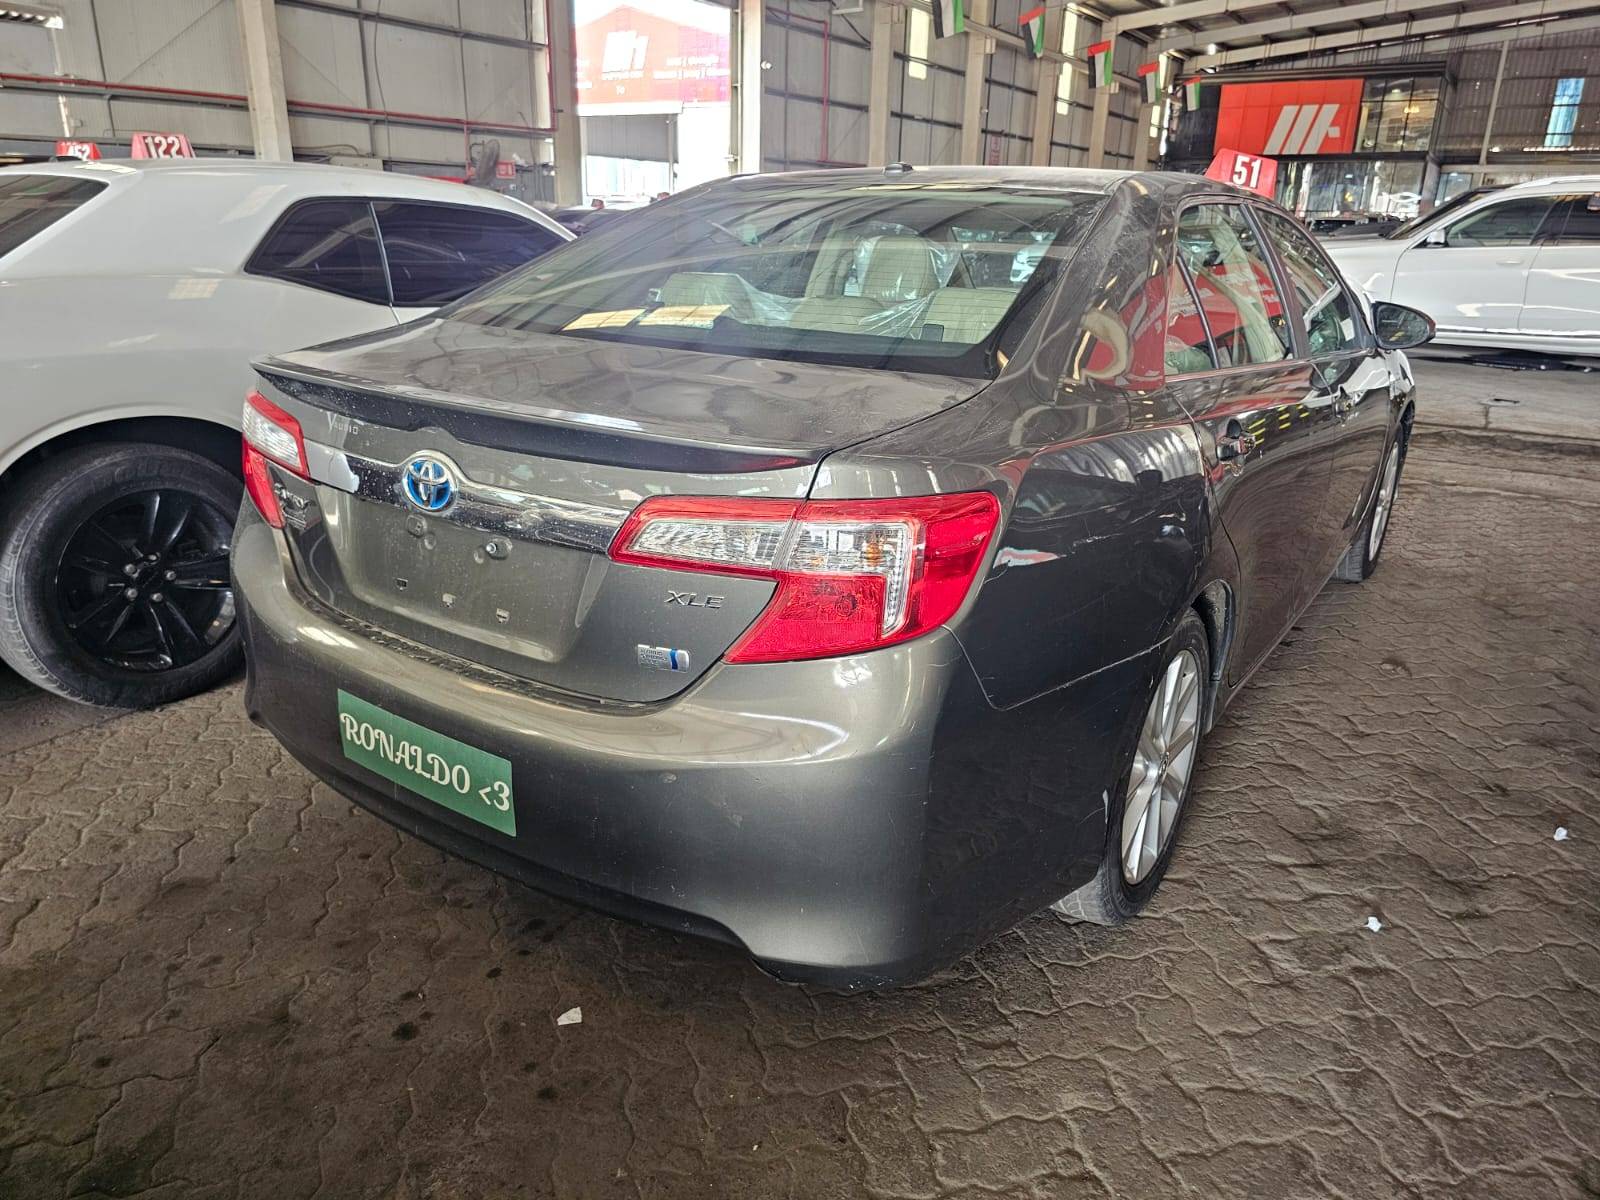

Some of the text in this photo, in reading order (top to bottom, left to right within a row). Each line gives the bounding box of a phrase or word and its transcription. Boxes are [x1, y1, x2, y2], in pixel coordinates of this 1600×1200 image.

[145, 136, 183, 158] 122
[1232, 154, 1261, 188] 51
[664, 590, 725, 609] XLE
[339, 712, 510, 811] RONALDO <3
